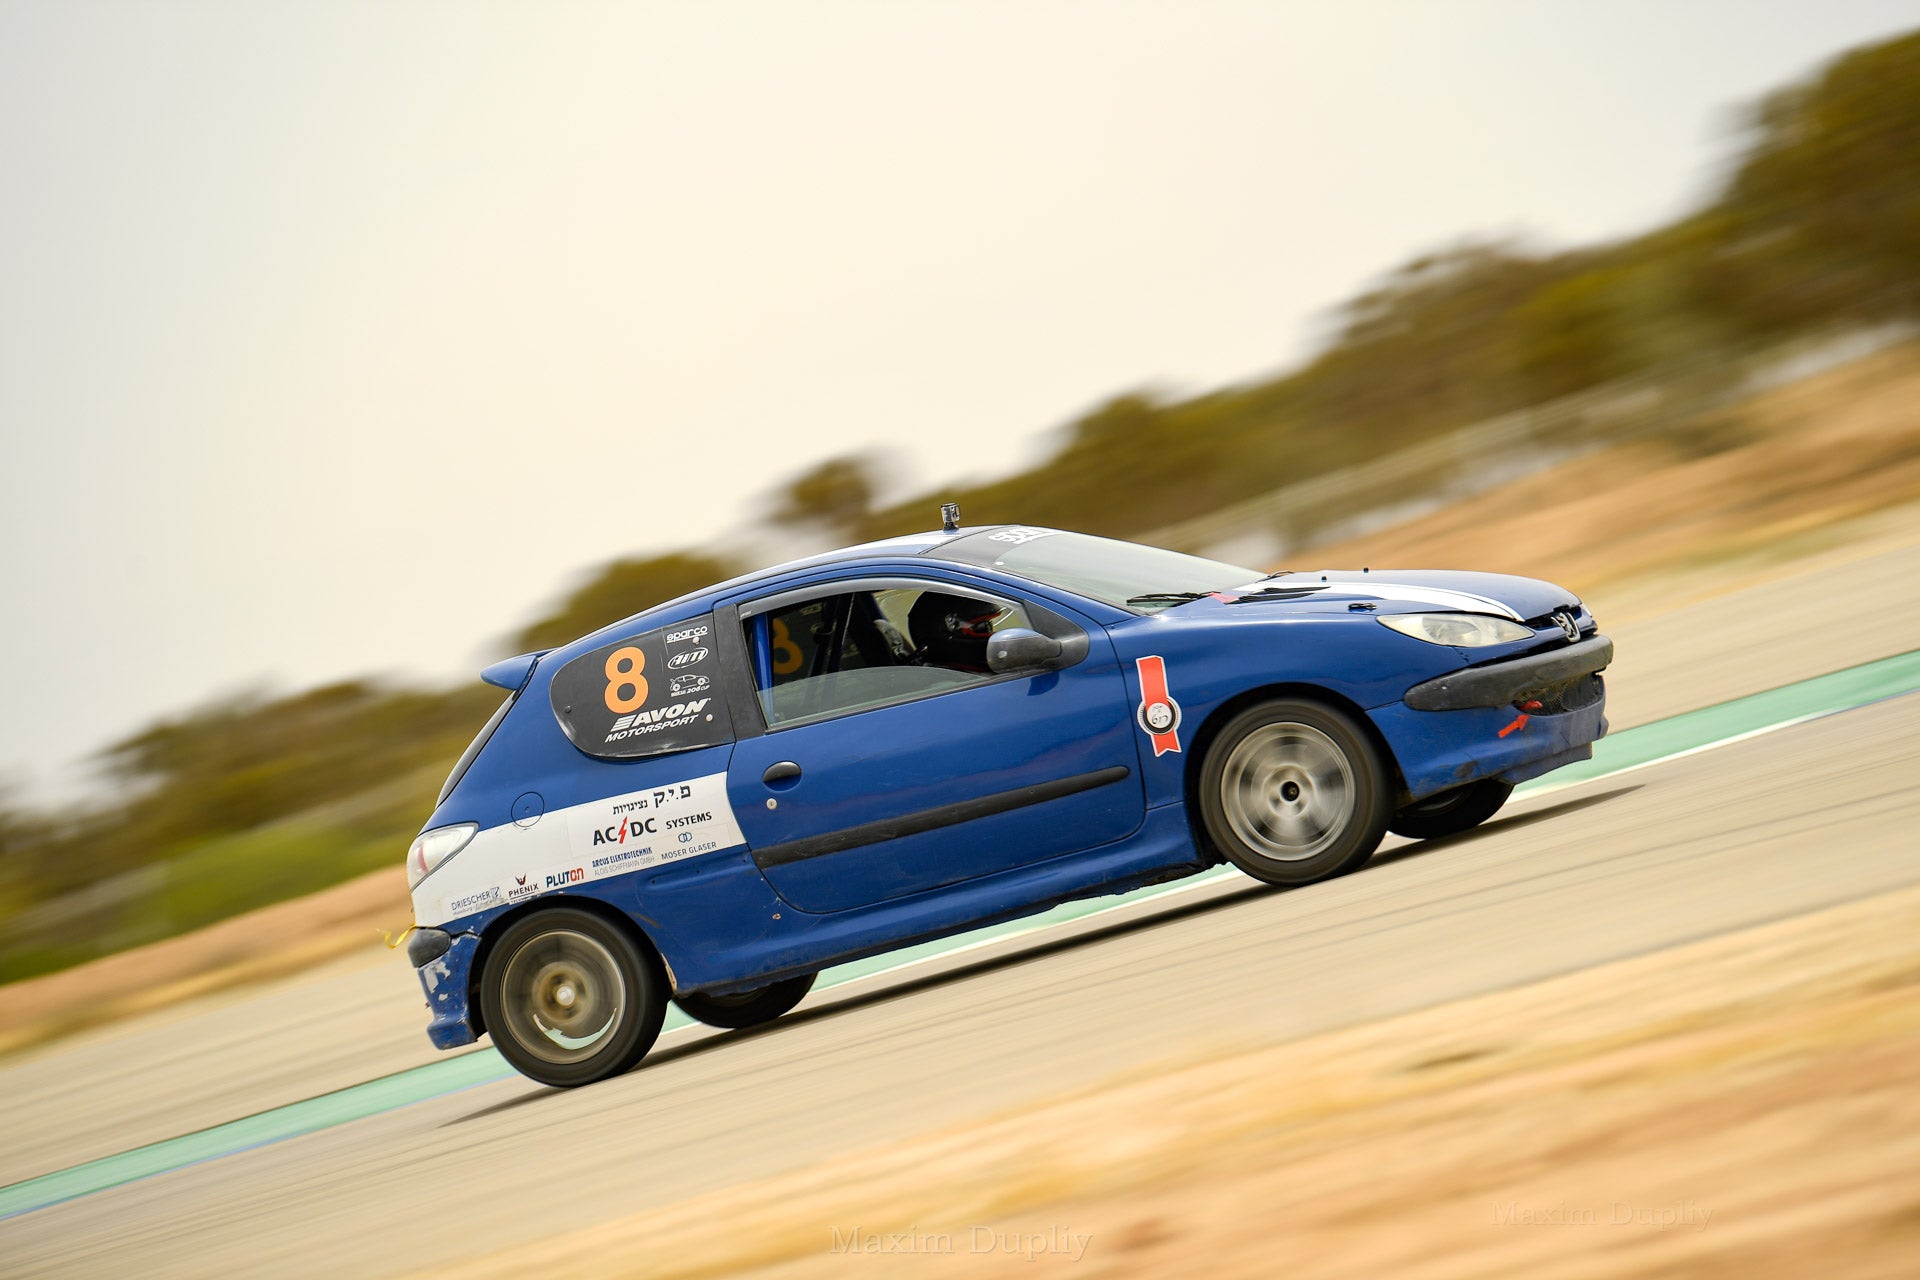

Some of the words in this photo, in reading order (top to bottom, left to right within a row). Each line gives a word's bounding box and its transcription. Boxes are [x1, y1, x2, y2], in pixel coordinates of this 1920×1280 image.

[667, 626, 708, 642] sparco
[604, 646, 649, 714] 8
[631, 698, 710, 728] AVON
[604, 714, 699, 743] MOTORSPORT
[613, 799, 649, 815] נציגויות
[666, 811, 712, 830] SYSTEMS
[592, 857, 610, 868] ARCUS
[610, 846, 653, 864] ELEKTROTECHNIK
[661, 848, 687, 861] MOSER
[688, 841, 717, 854] GLASER
[451, 890, 491, 911] DRIESCHER
[508, 883, 540, 898] PHENIX
